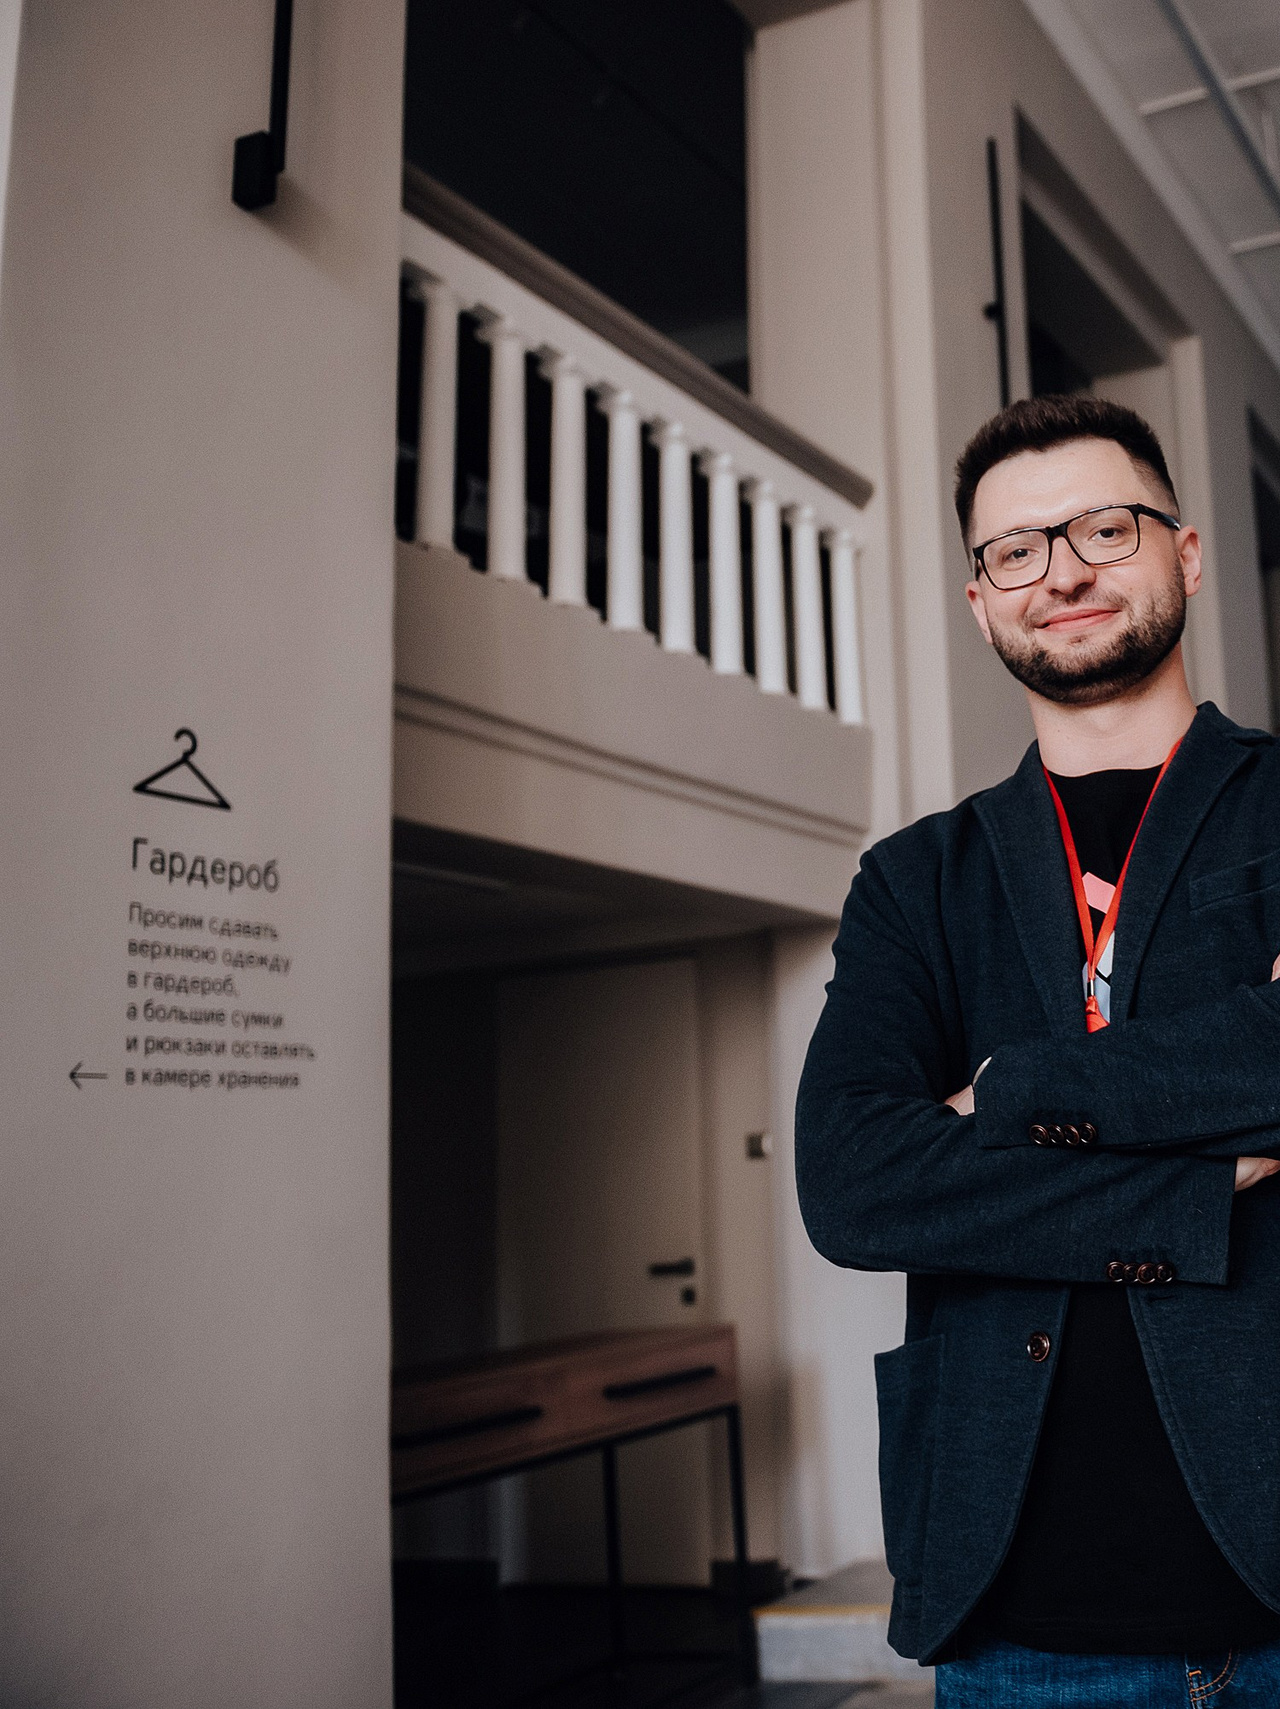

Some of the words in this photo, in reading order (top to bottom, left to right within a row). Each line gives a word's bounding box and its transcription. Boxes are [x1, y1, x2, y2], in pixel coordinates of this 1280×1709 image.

[130, 836, 280, 893] Гардероб
[129, 902, 203, 931] Просим
[208, 916, 279, 942] сдавать
[128, 938, 217, 965] верхнюю
[222, 948, 292, 976] одежду
[127, 970, 138, 989] в
[126, 1002, 138, 1022] а
[143, 998, 226, 1026] большие
[231, 1009, 284, 1032] сумки
[125, 1035, 138, 1053] и
[144, 1036, 226, 1058] рюкзаки
[125, 1068, 136, 1086] в
[142, 1068, 213, 1091] камере
[217, 1071, 300, 1091] хранения
